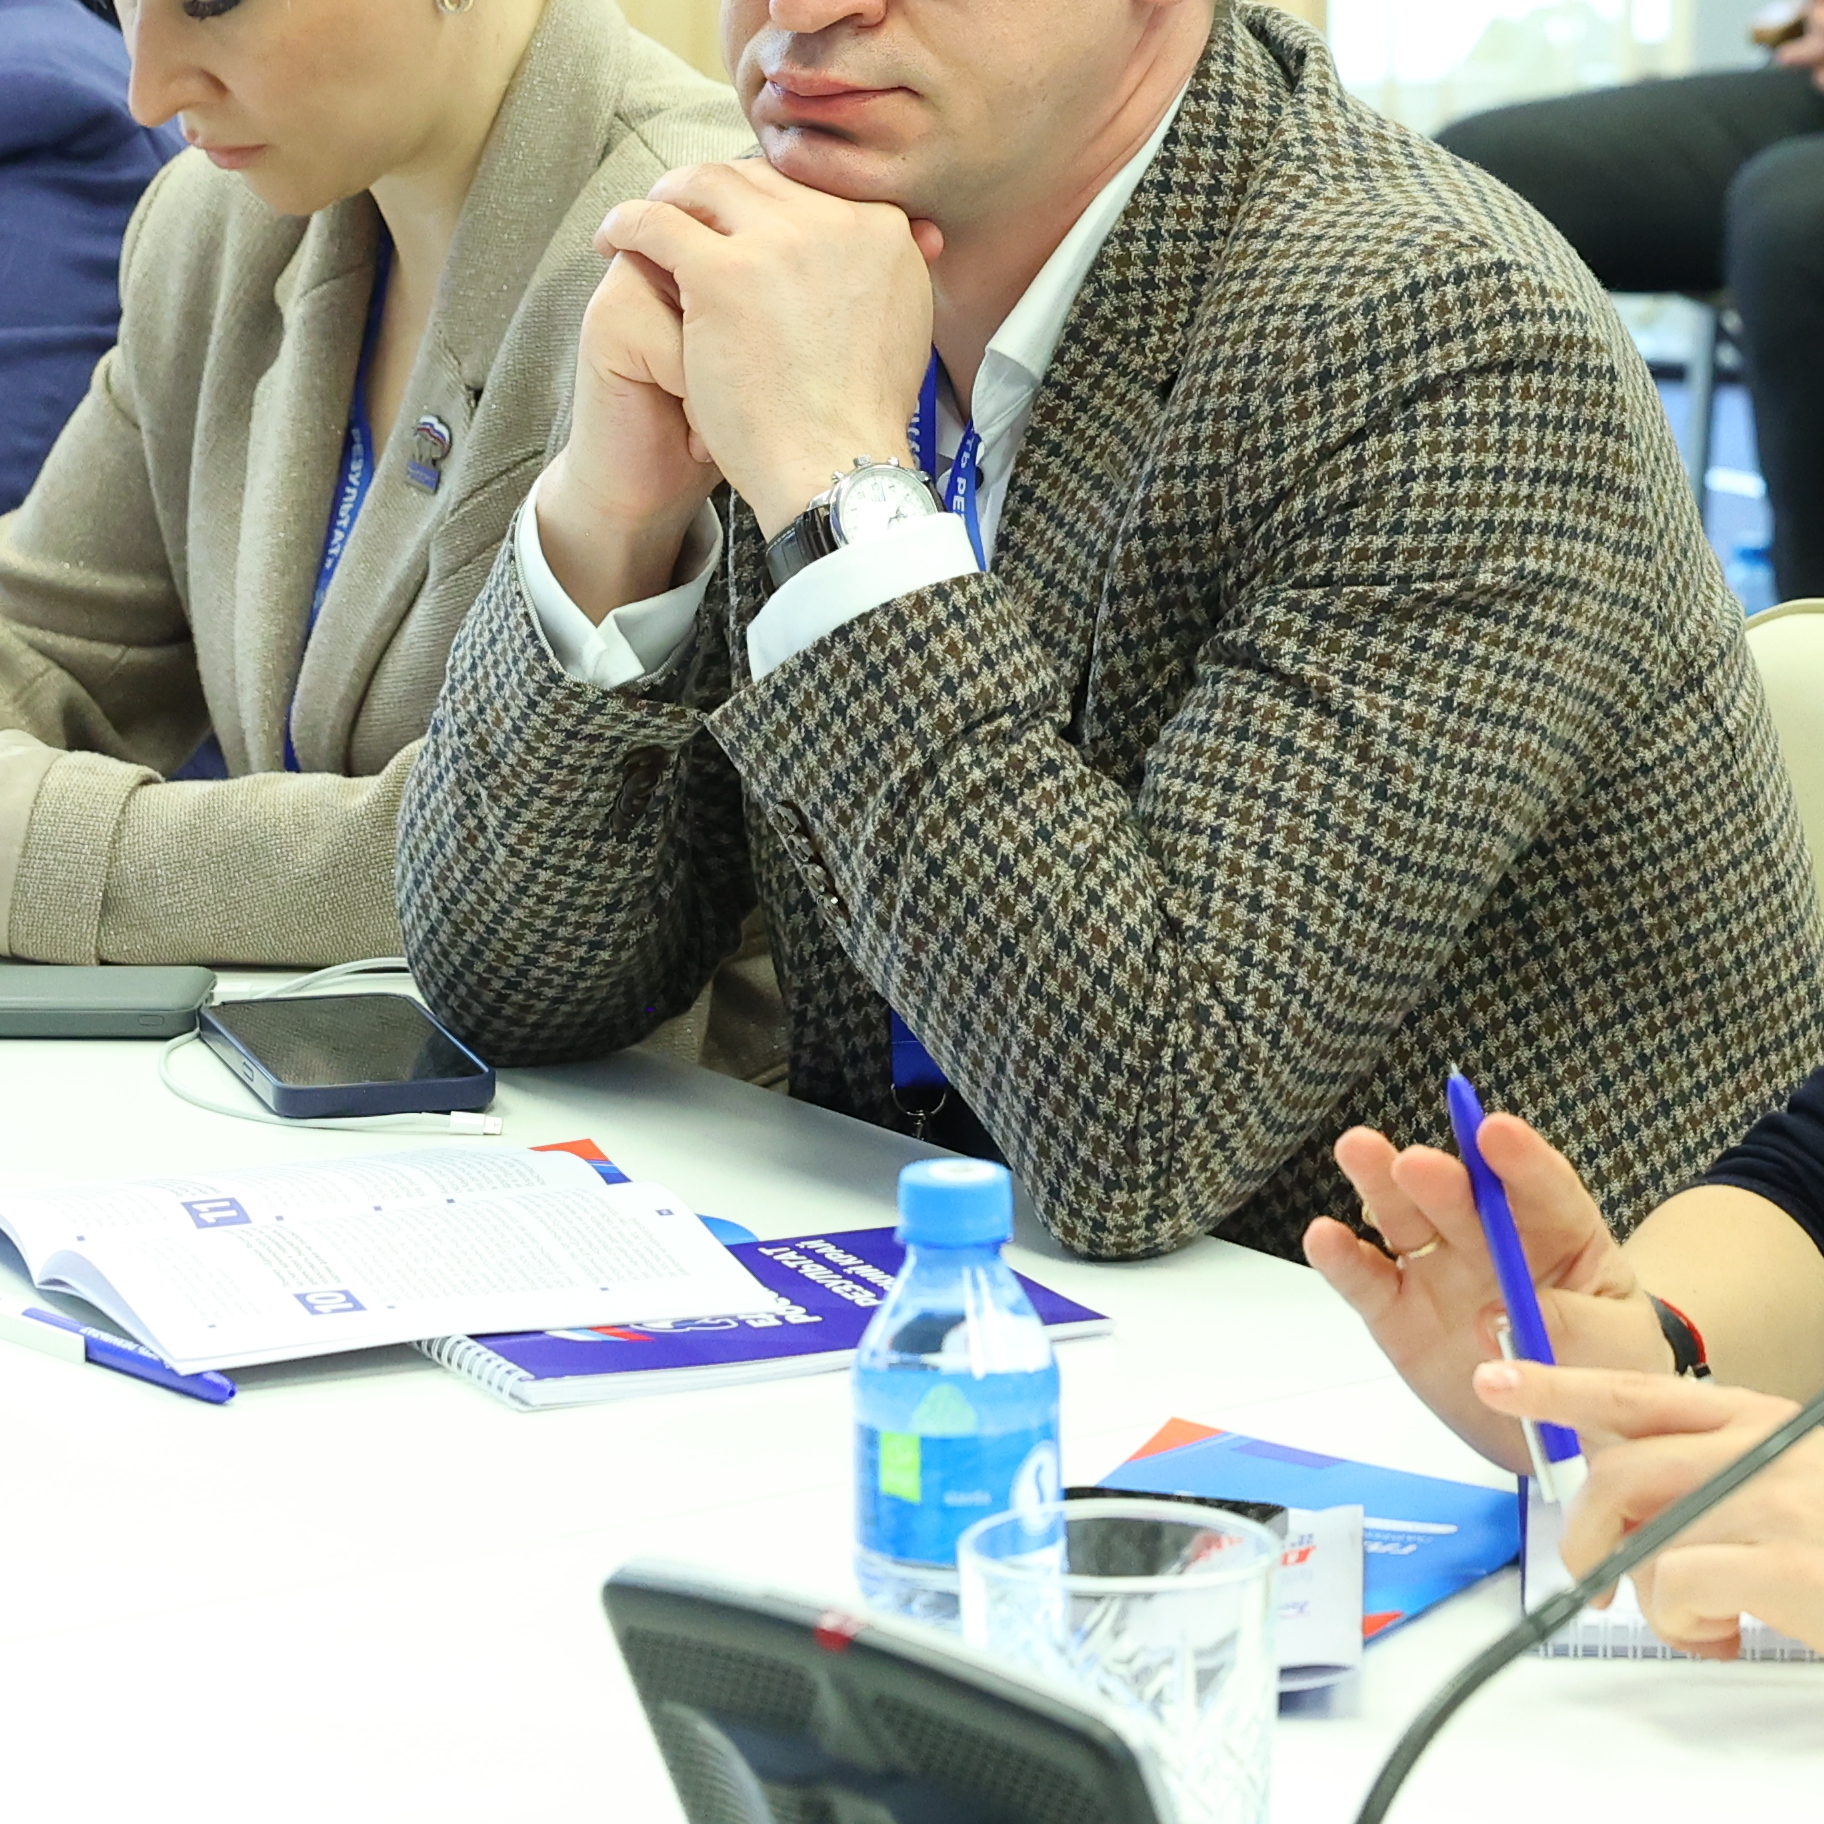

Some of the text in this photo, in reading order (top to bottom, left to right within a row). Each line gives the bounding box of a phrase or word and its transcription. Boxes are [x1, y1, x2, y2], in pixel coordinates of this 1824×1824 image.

[190, 1200, 240, 1224] 11
[794, 1239, 865, 1268] КРАЙ
[304, 1291, 355, 1314] 10
